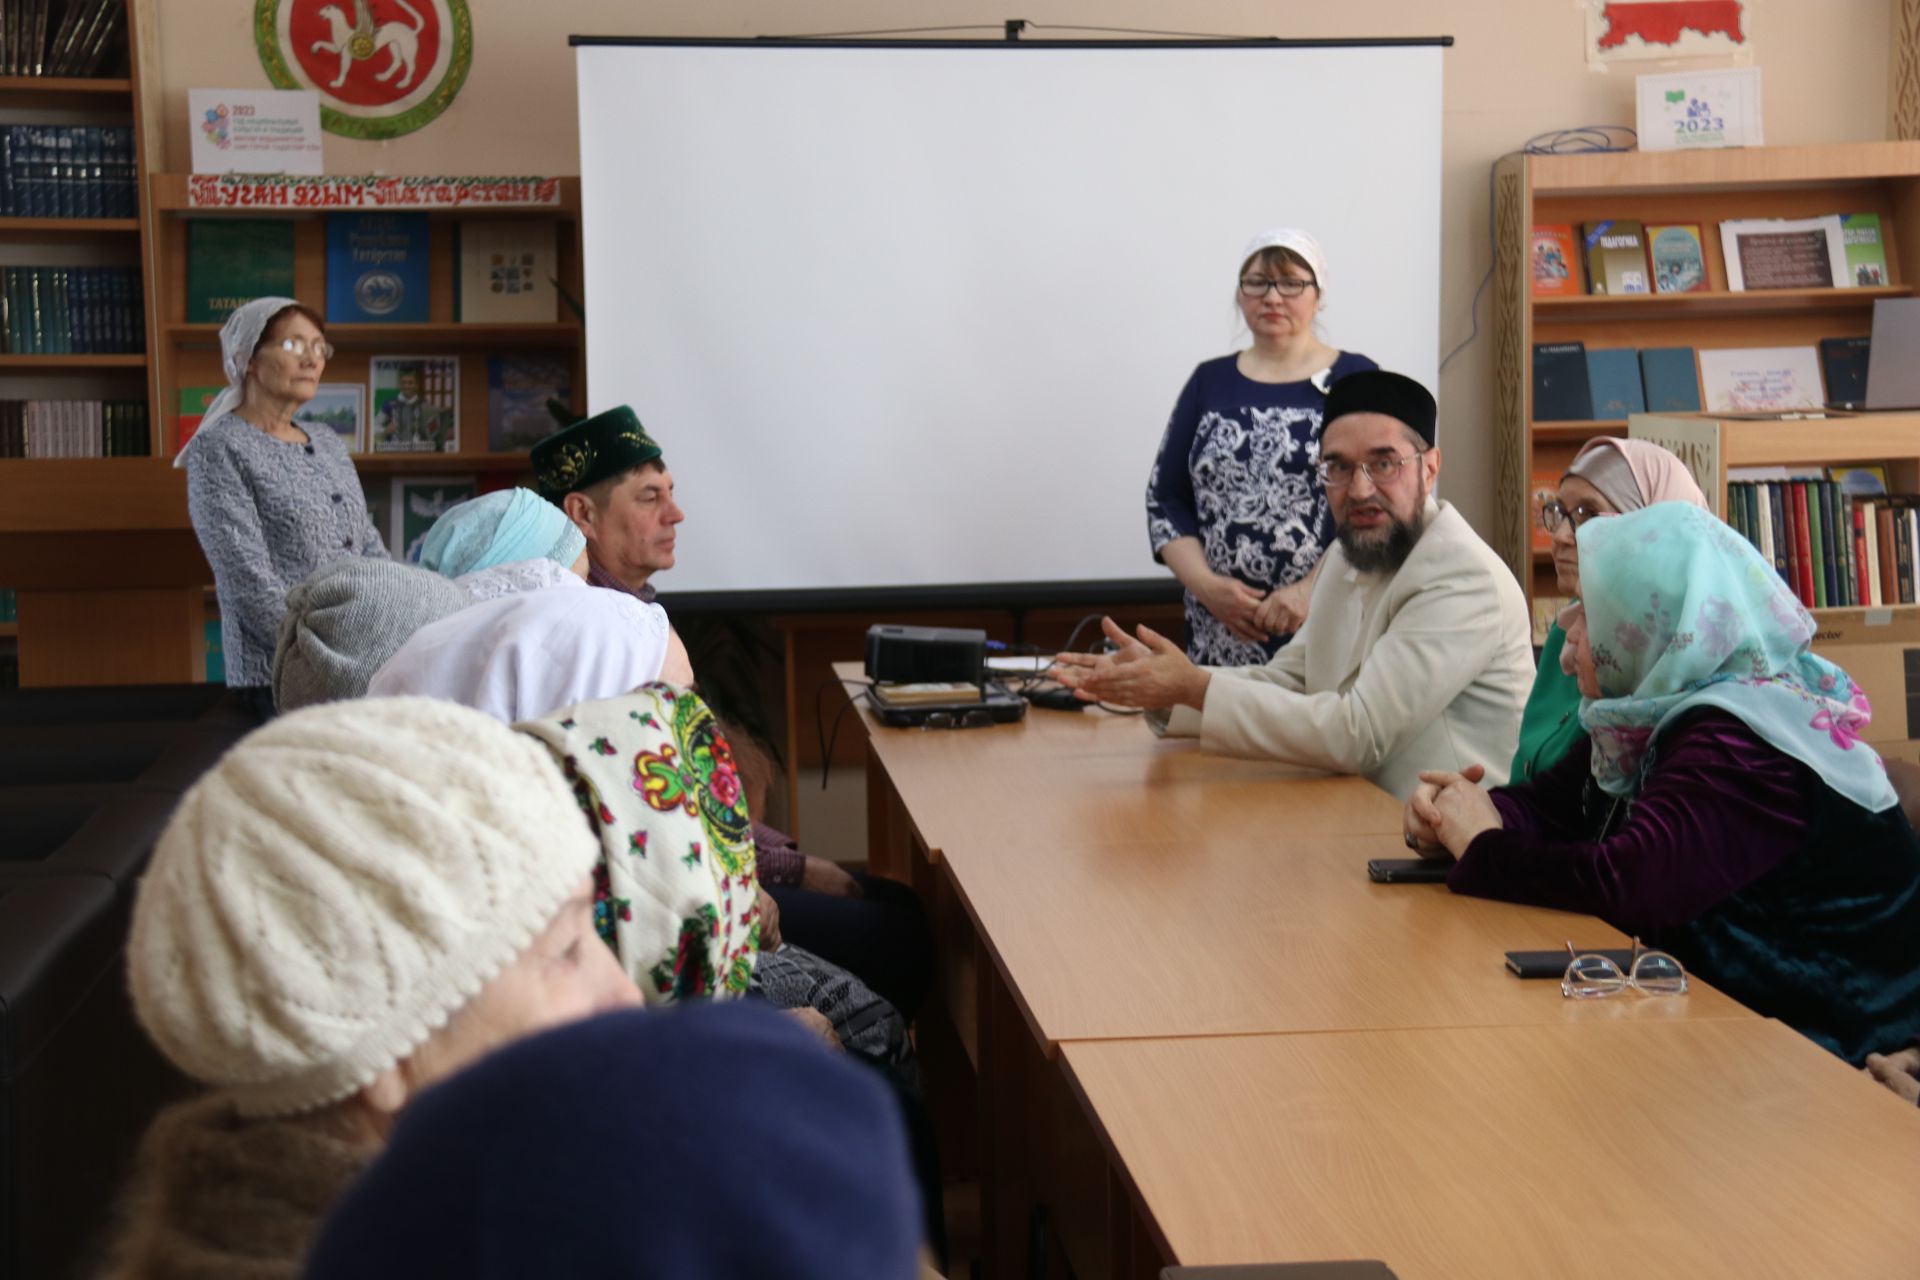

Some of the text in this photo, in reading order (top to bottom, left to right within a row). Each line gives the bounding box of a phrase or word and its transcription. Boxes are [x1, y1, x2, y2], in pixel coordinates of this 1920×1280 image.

[1674, 117, 1724, 134] 2023
[208, 296, 249, 310] ТАТАР
[1812, 629, 1843, 640] ector
